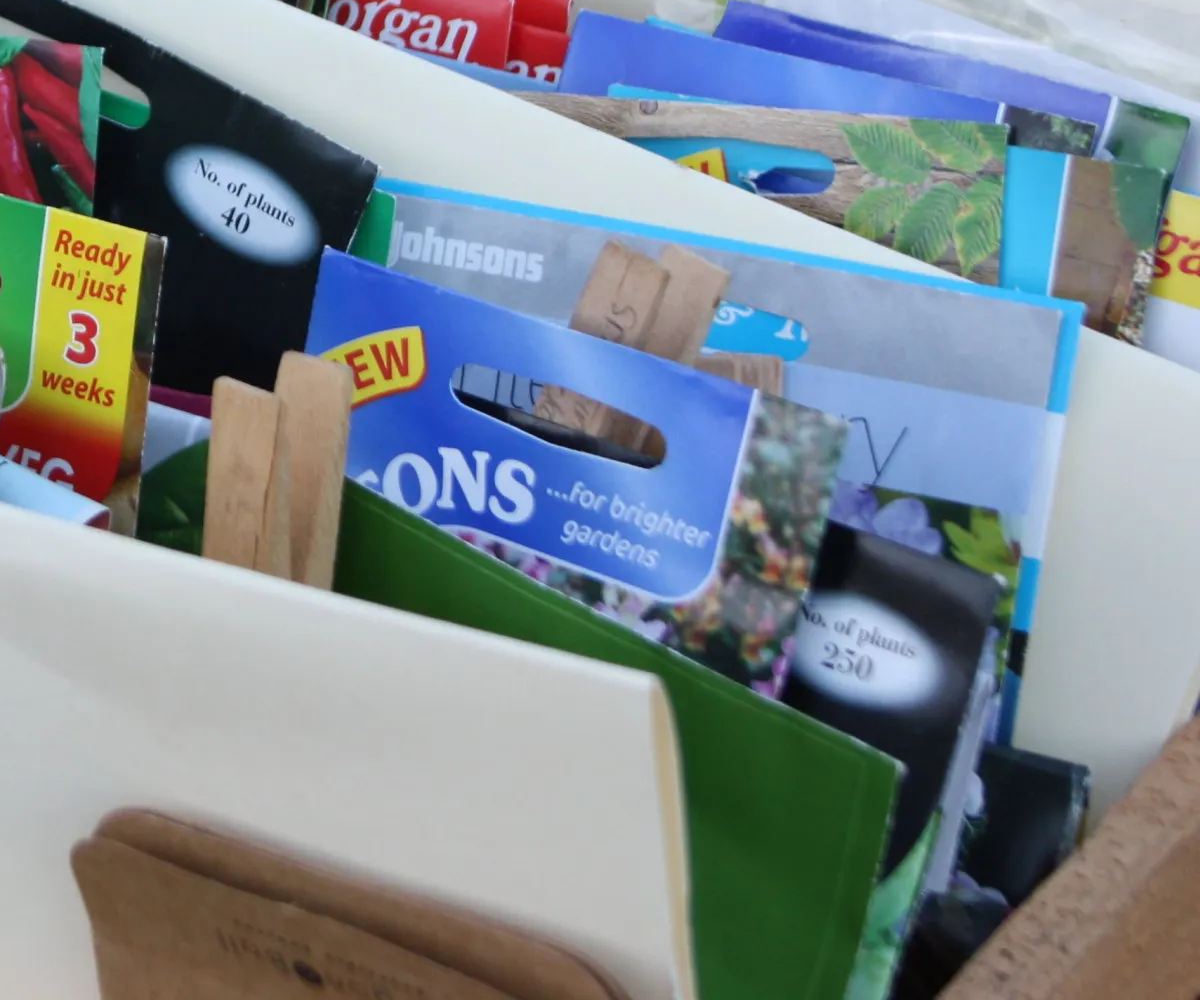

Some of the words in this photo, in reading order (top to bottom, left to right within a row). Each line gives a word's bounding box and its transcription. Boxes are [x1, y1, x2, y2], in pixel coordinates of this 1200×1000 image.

[194, 157, 221, 187] No.
[226, 182, 247, 198] of
[243, 191, 297, 229] plants
[220, 206, 251, 235] 40
[54, 229, 132, 276] Ready
[51, 263, 76, 291] in
[76, 271, 128, 305] just
[63, 310, 100, 367] 3
[340, 337, 410, 390] EW
[41, 369, 116, 407] weeks
[354, 446, 536, 524] ONS
[608, 493, 713, 549] brighter
[559, 519, 661, 569] gardens
[820, 641, 874, 682] 250
[833, 617, 858, 637] of
[855, 625, 915, 659] plants
